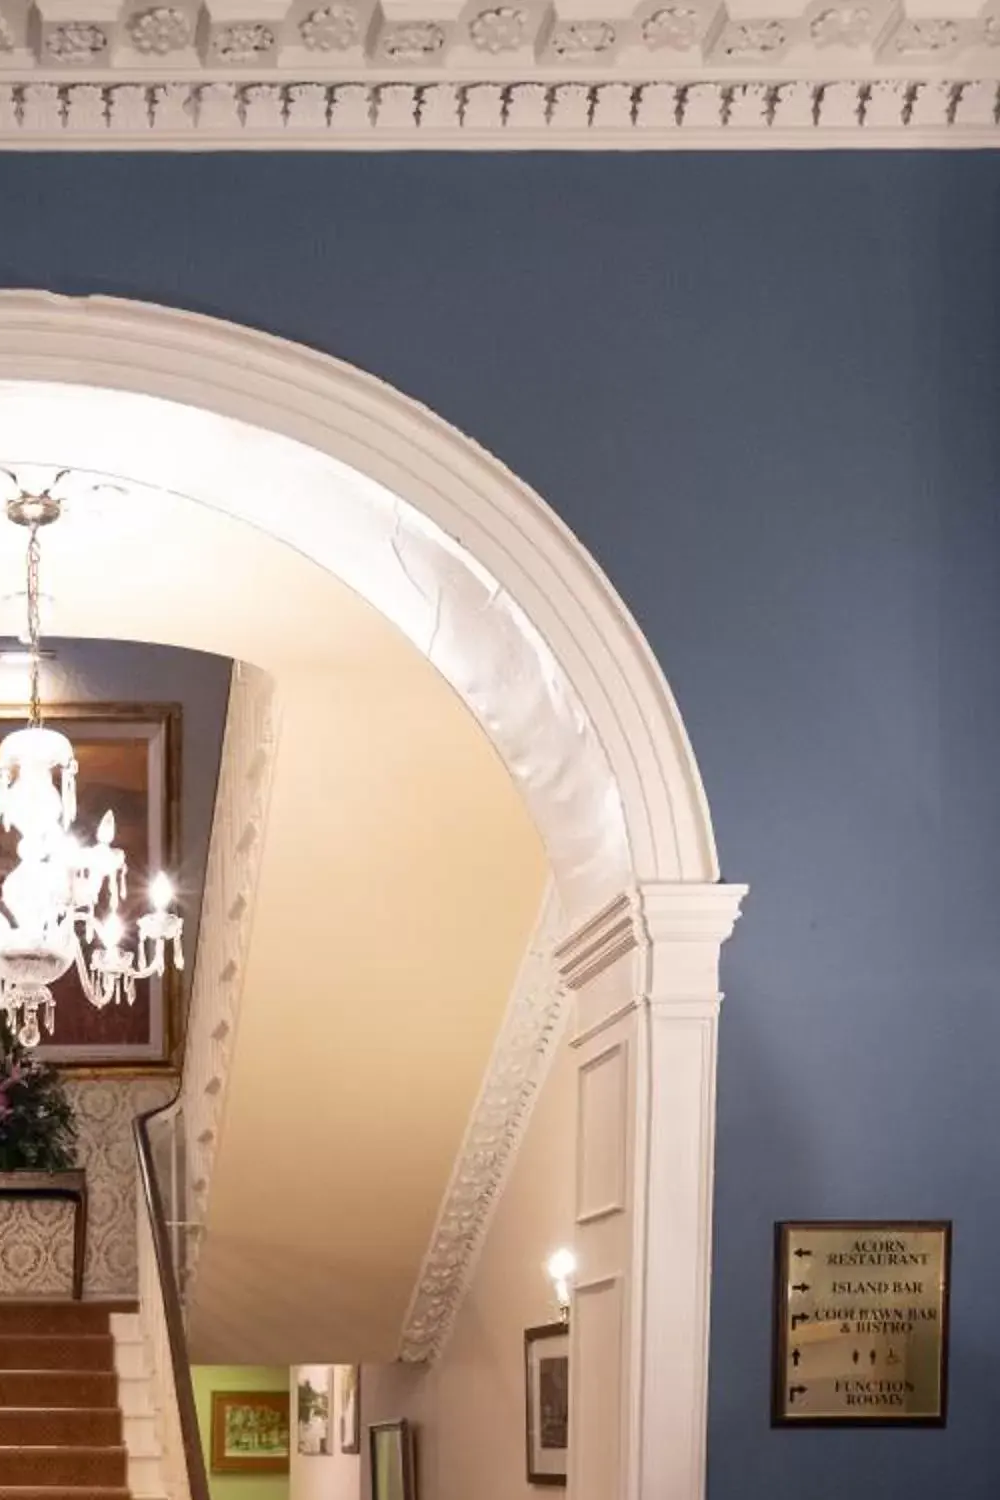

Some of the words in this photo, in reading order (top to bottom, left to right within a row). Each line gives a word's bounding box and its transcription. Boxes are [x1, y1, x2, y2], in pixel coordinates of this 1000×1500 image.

[852, 1240, 905, 1252] ACORN
[826, 1254, 929, 1265] RESTAURANT
[832, 1282, 889, 1293] ISLAND
[893, 1282, 923, 1293] BAR
[907, 1309, 937, 1320] BAR
[840, 1325, 851, 1334] &
[856, 1322, 913, 1334] BISTRO
[834, 1380, 914, 1392] FUNCTION
[846, 1394, 904, 1405] ROOMS
